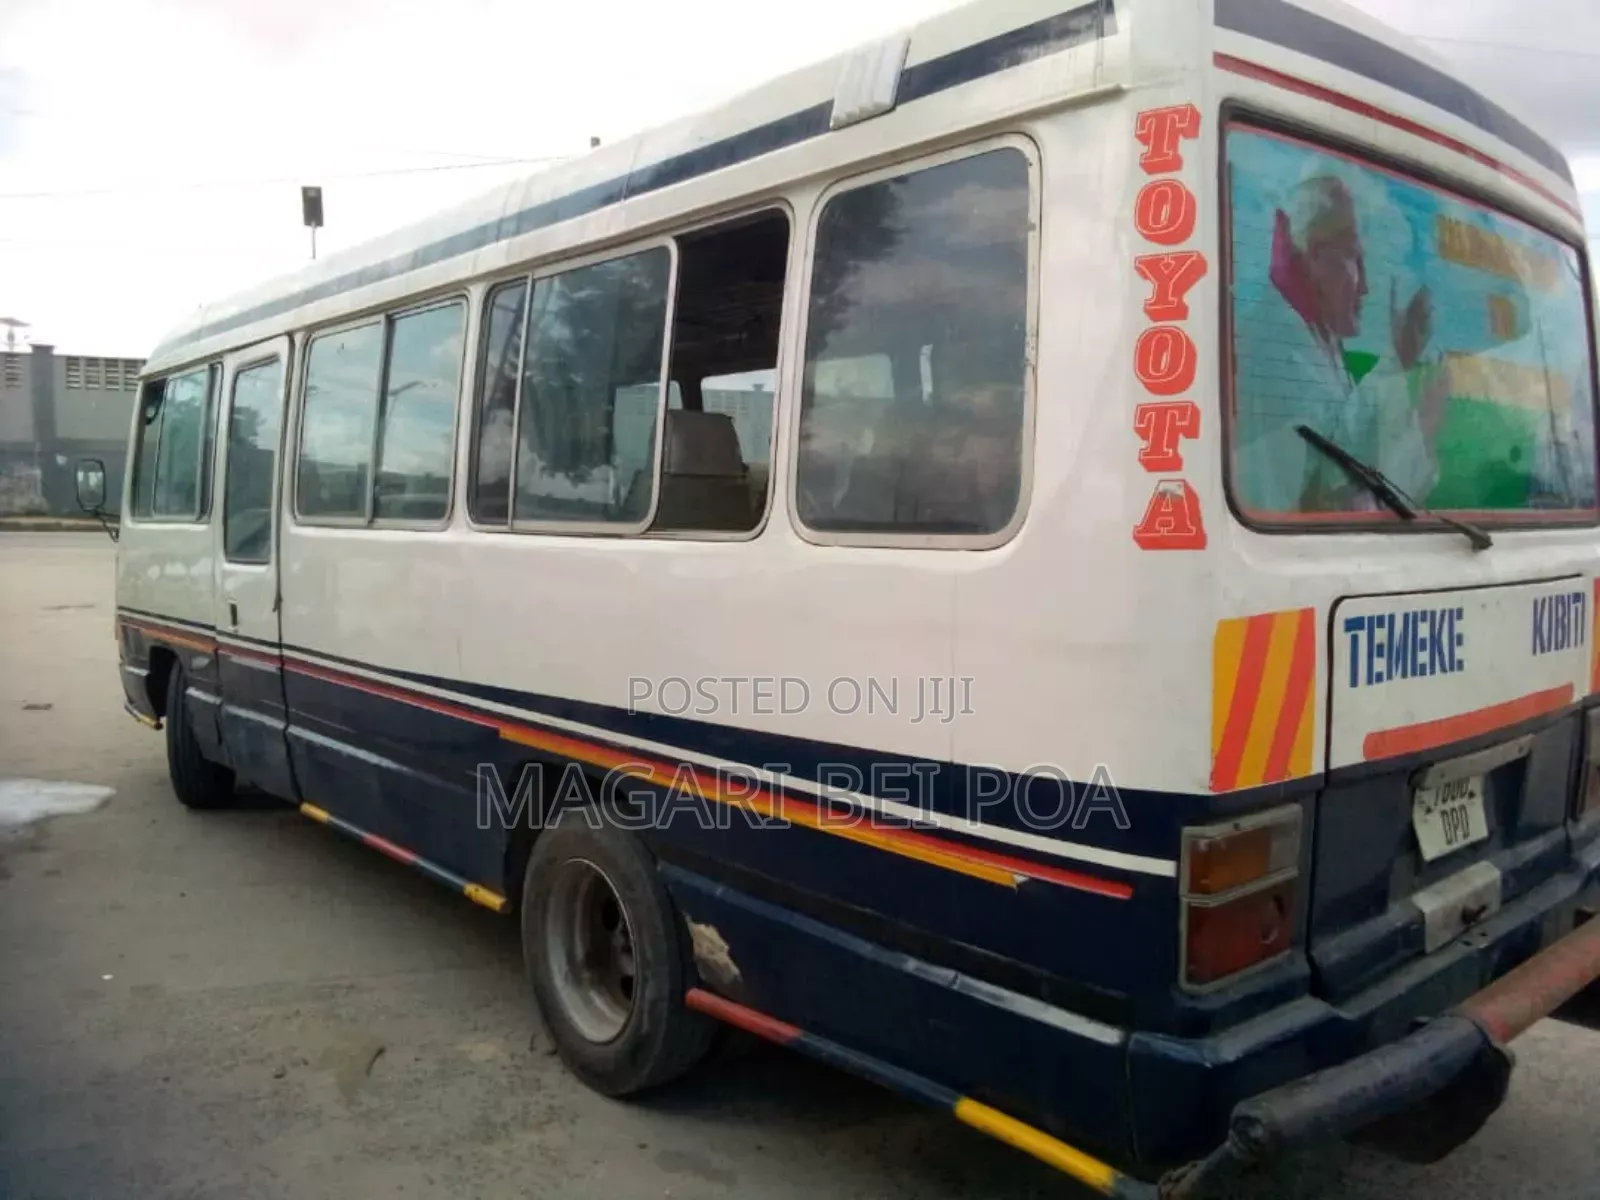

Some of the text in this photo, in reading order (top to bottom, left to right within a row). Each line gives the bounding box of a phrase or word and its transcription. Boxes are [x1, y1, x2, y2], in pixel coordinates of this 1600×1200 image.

[1133, 103, 1207, 550] TOYOTA
[1344, 607, 1464, 688] TEMEKE
[1532, 592, 1586, 656] KIBITI
